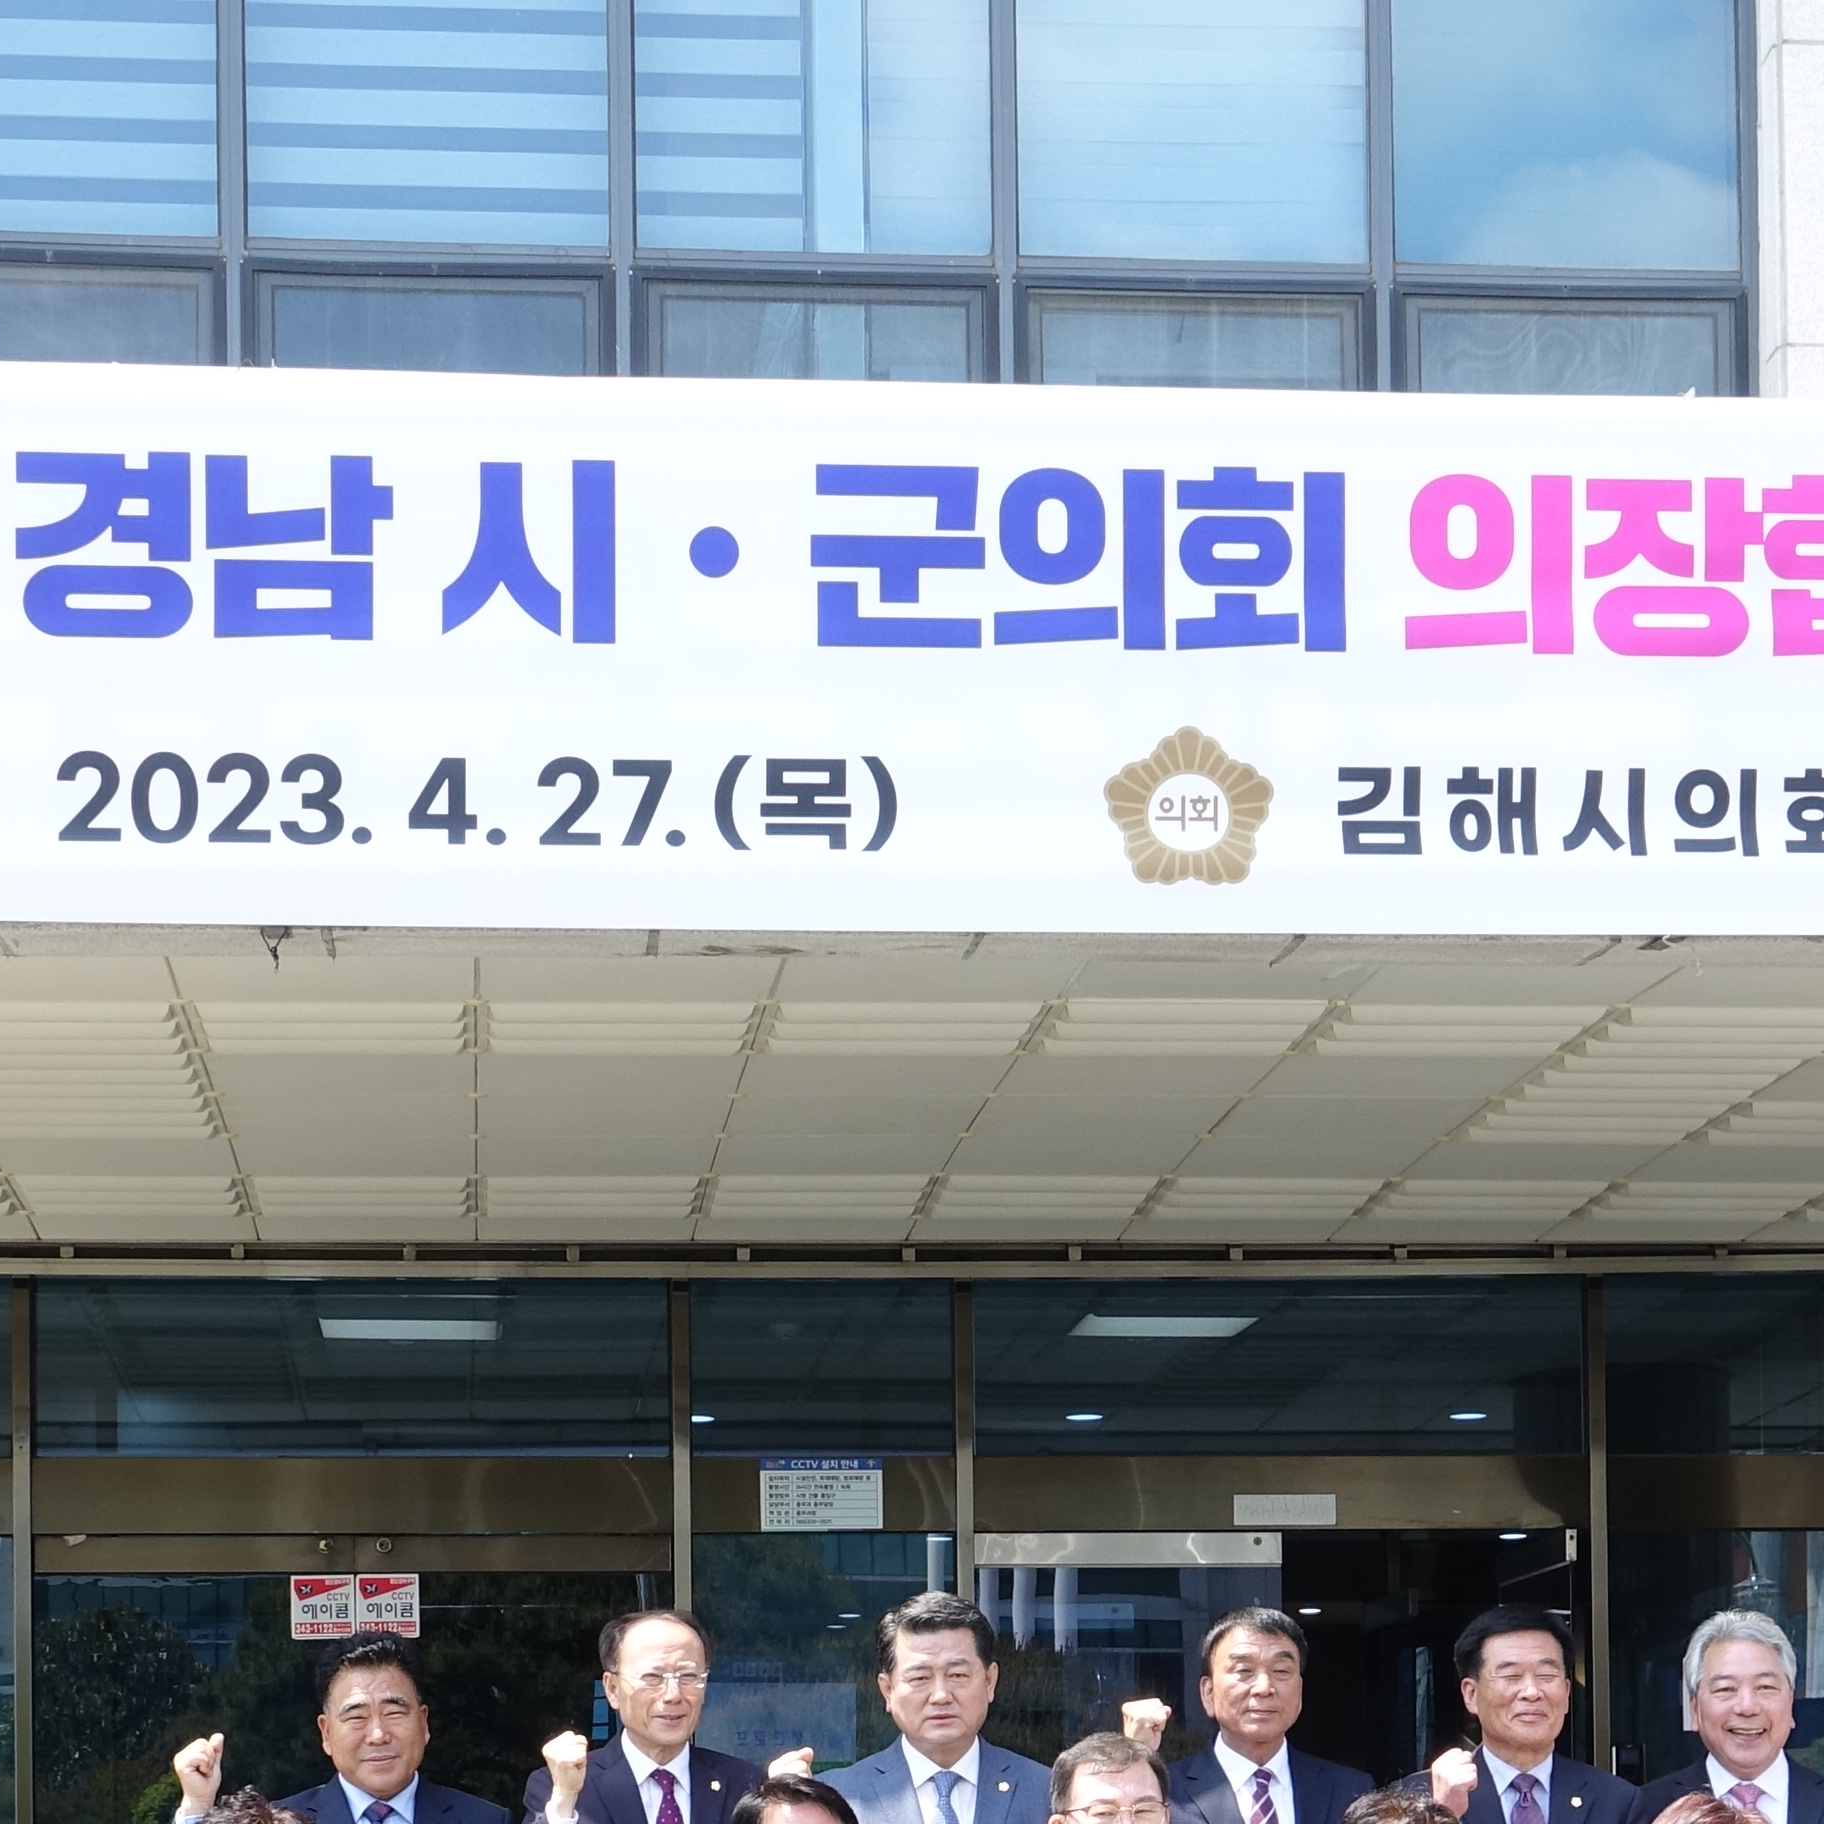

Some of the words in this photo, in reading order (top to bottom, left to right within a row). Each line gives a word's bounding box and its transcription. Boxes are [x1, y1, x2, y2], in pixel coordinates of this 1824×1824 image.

[15, 451, 394, 641] 경남
[56, 751, 373, 845] 2023.
[408, 757, 508, 847] 4.
[537, 756, 899, 853] 27.(목)
[1155, 795, 1218, 832] 의회
[791, 1460, 818, 1469] CCTV
[326, 1593, 351, 1602] CCTV
[391, 1592, 415, 1601] CCTV
[301, 1603, 349, 1619] 에이콤
[366, 1602, 414, 1619] 에이콤
